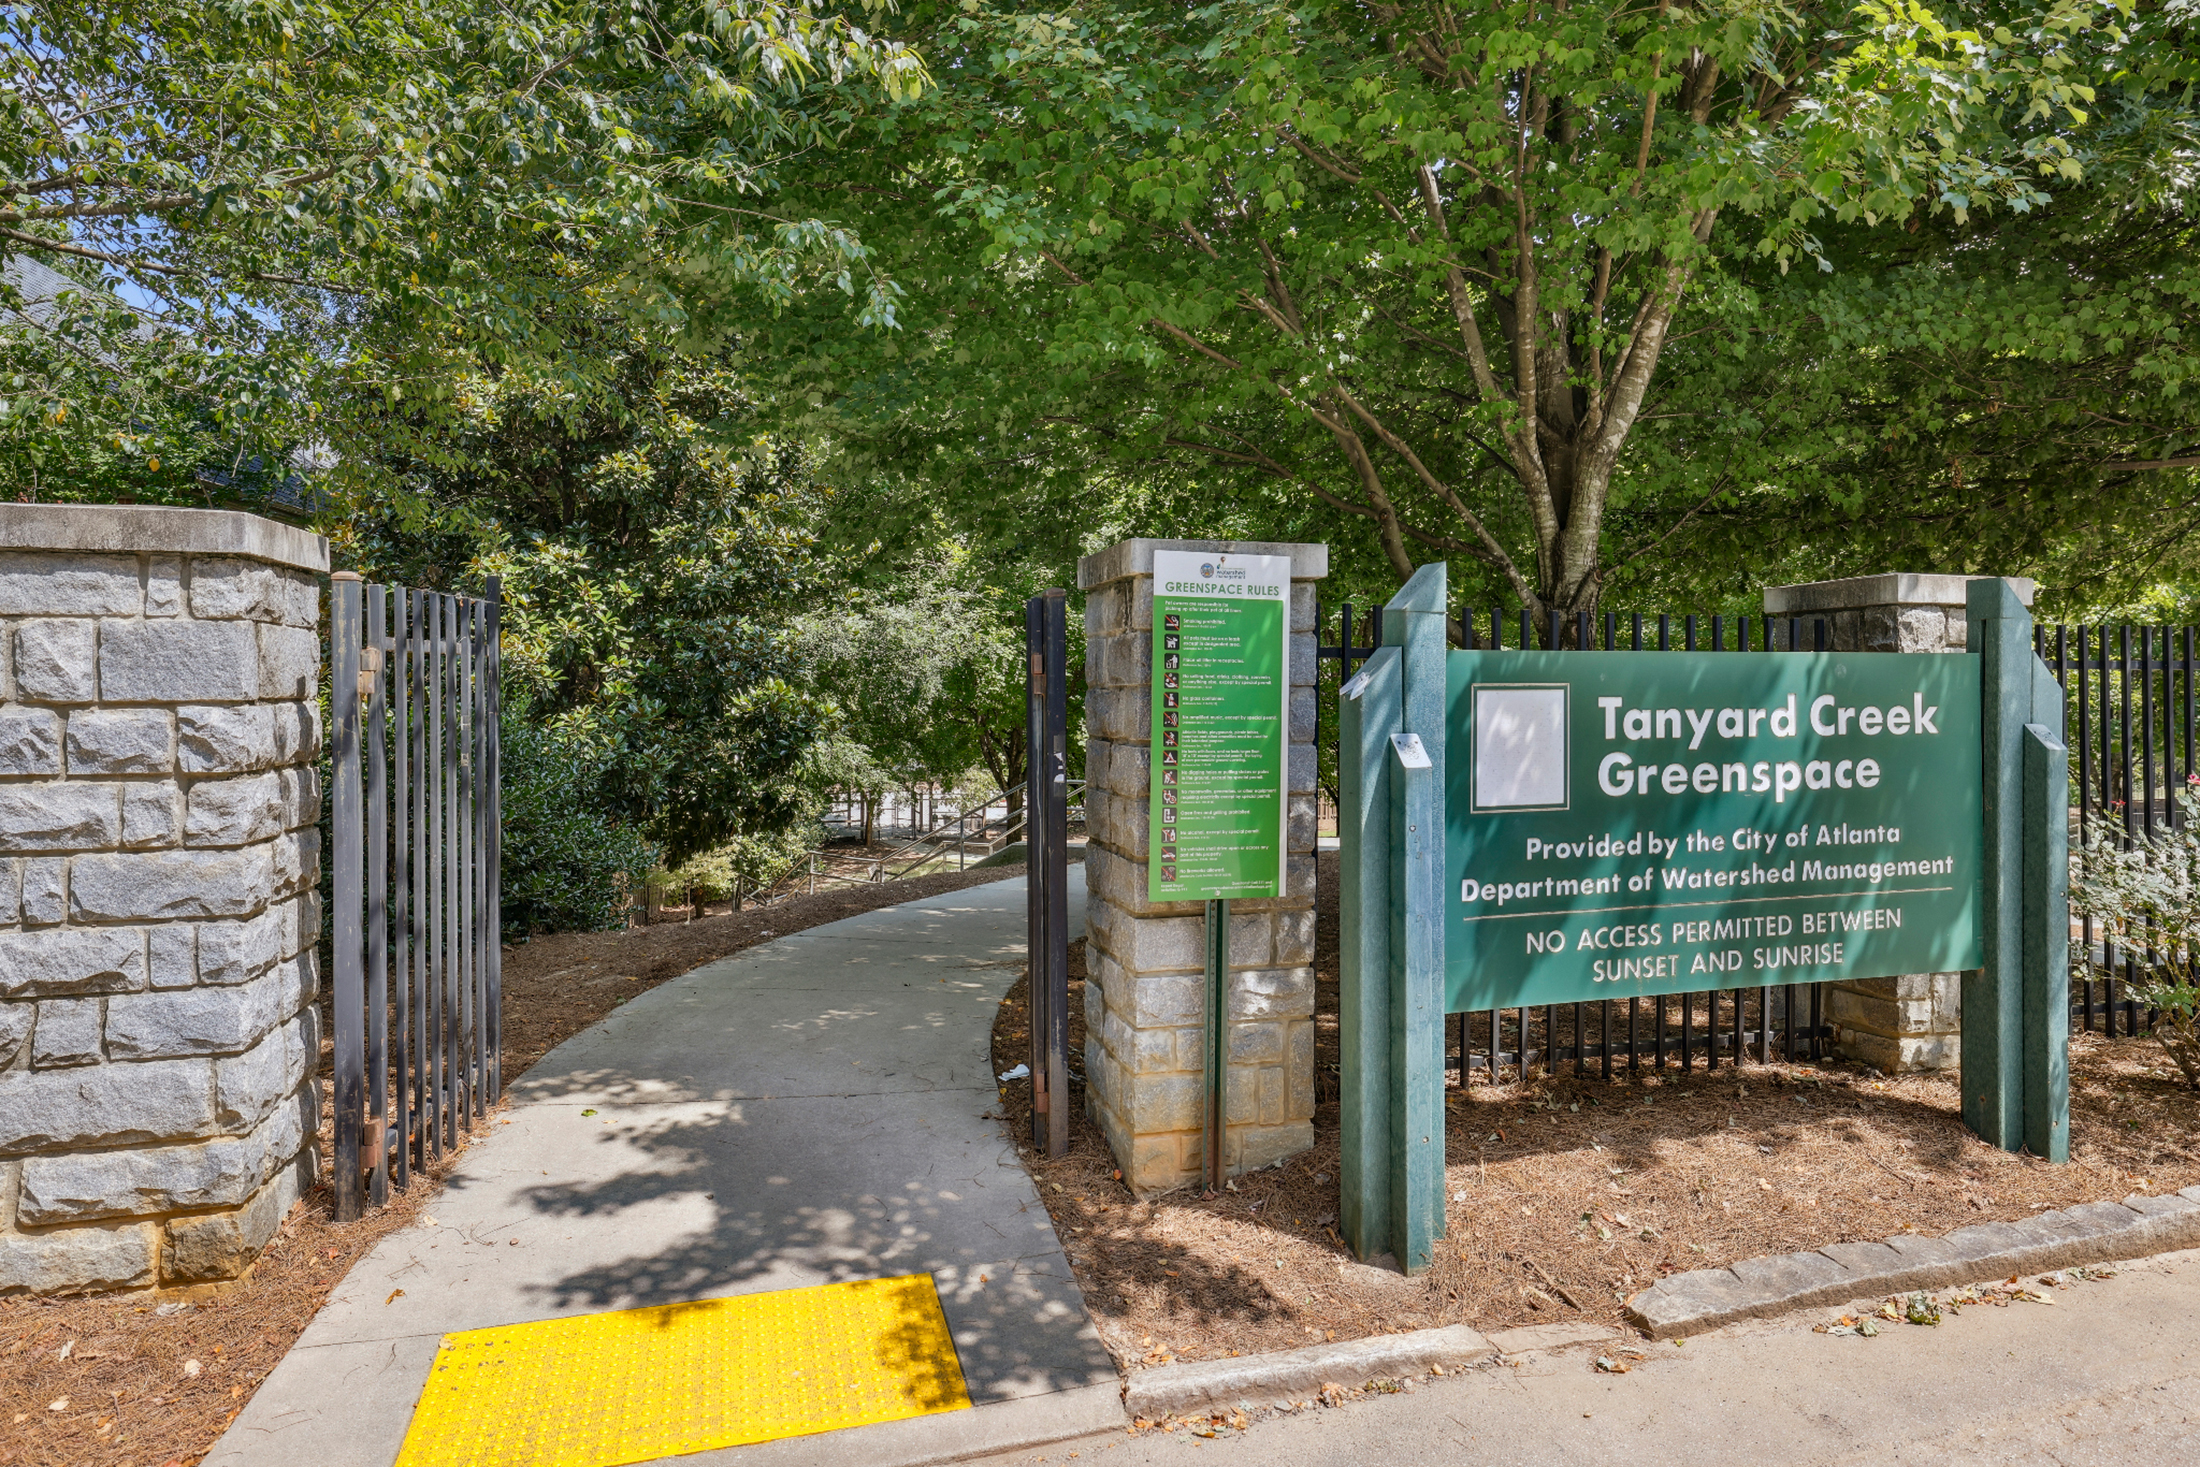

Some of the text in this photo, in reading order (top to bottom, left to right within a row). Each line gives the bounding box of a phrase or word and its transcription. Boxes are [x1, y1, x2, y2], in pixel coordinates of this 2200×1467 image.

[1165, 582, 1279, 596] GREENSPACE RULES
[1598, 692, 1939, 750] Tanyard Creek
[1598, 752, 1880, 802] Greenspace
[1526, 823, 1900, 860] Provided by the City of Atlanta
[1461, 856, 1954, 905] Department of Watershed Management
[1526, 908, 1901, 954] NO ACCESS PERMITTED BETWEEN
[1593, 942, 1844, 982] SUNSET AND SUNRISE
